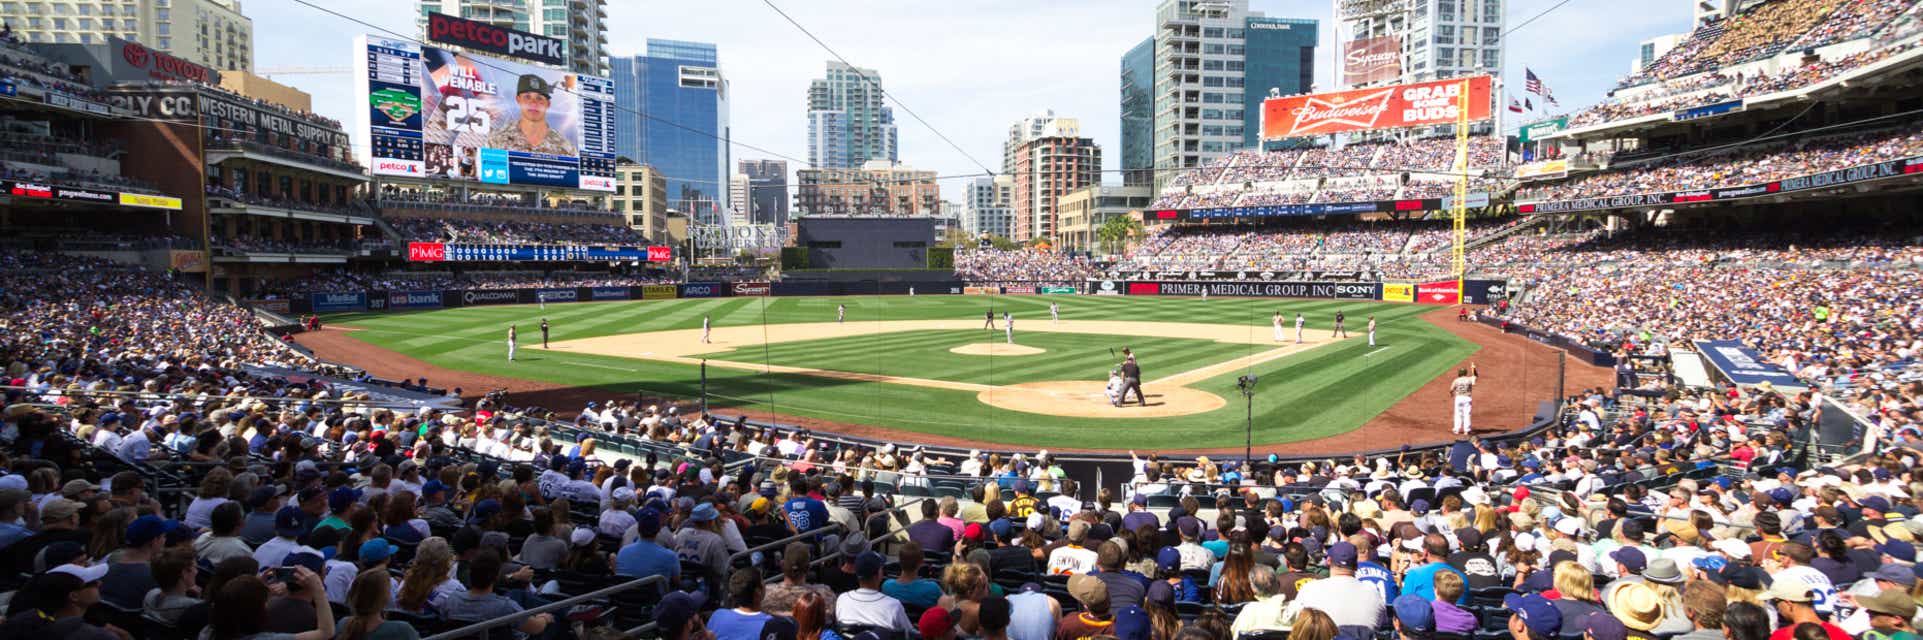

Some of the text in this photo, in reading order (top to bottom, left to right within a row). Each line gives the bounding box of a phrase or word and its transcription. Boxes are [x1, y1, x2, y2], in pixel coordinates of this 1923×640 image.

[151, 51, 209, 81] TOYOTA
[1346, 48, 1397, 66] Sycuan
[440, 75, 497, 94] VENABLE
[1403, 83, 1459, 101] GRAB
[446, 95, 490, 136] 25
[1292, 100, 1389, 121] Budweiser
[1403, 104, 1459, 122] BUDS
[200, 95, 256, 125] WESTERN
[261, 112, 294, 136] METAL
[297, 123, 331, 145] SUPPLY
[380, 162, 407, 171] petco
[1571, 200, 1610, 210] MEDICAL
[464, 291, 516, 303] QUALCOMM
[686, 286, 711, 295] ARCO
[1211, 284, 1262, 296] MEDICAL
[1265, 285, 1308, 297] GROUP,
[1337, 285, 1375, 294] SONY
